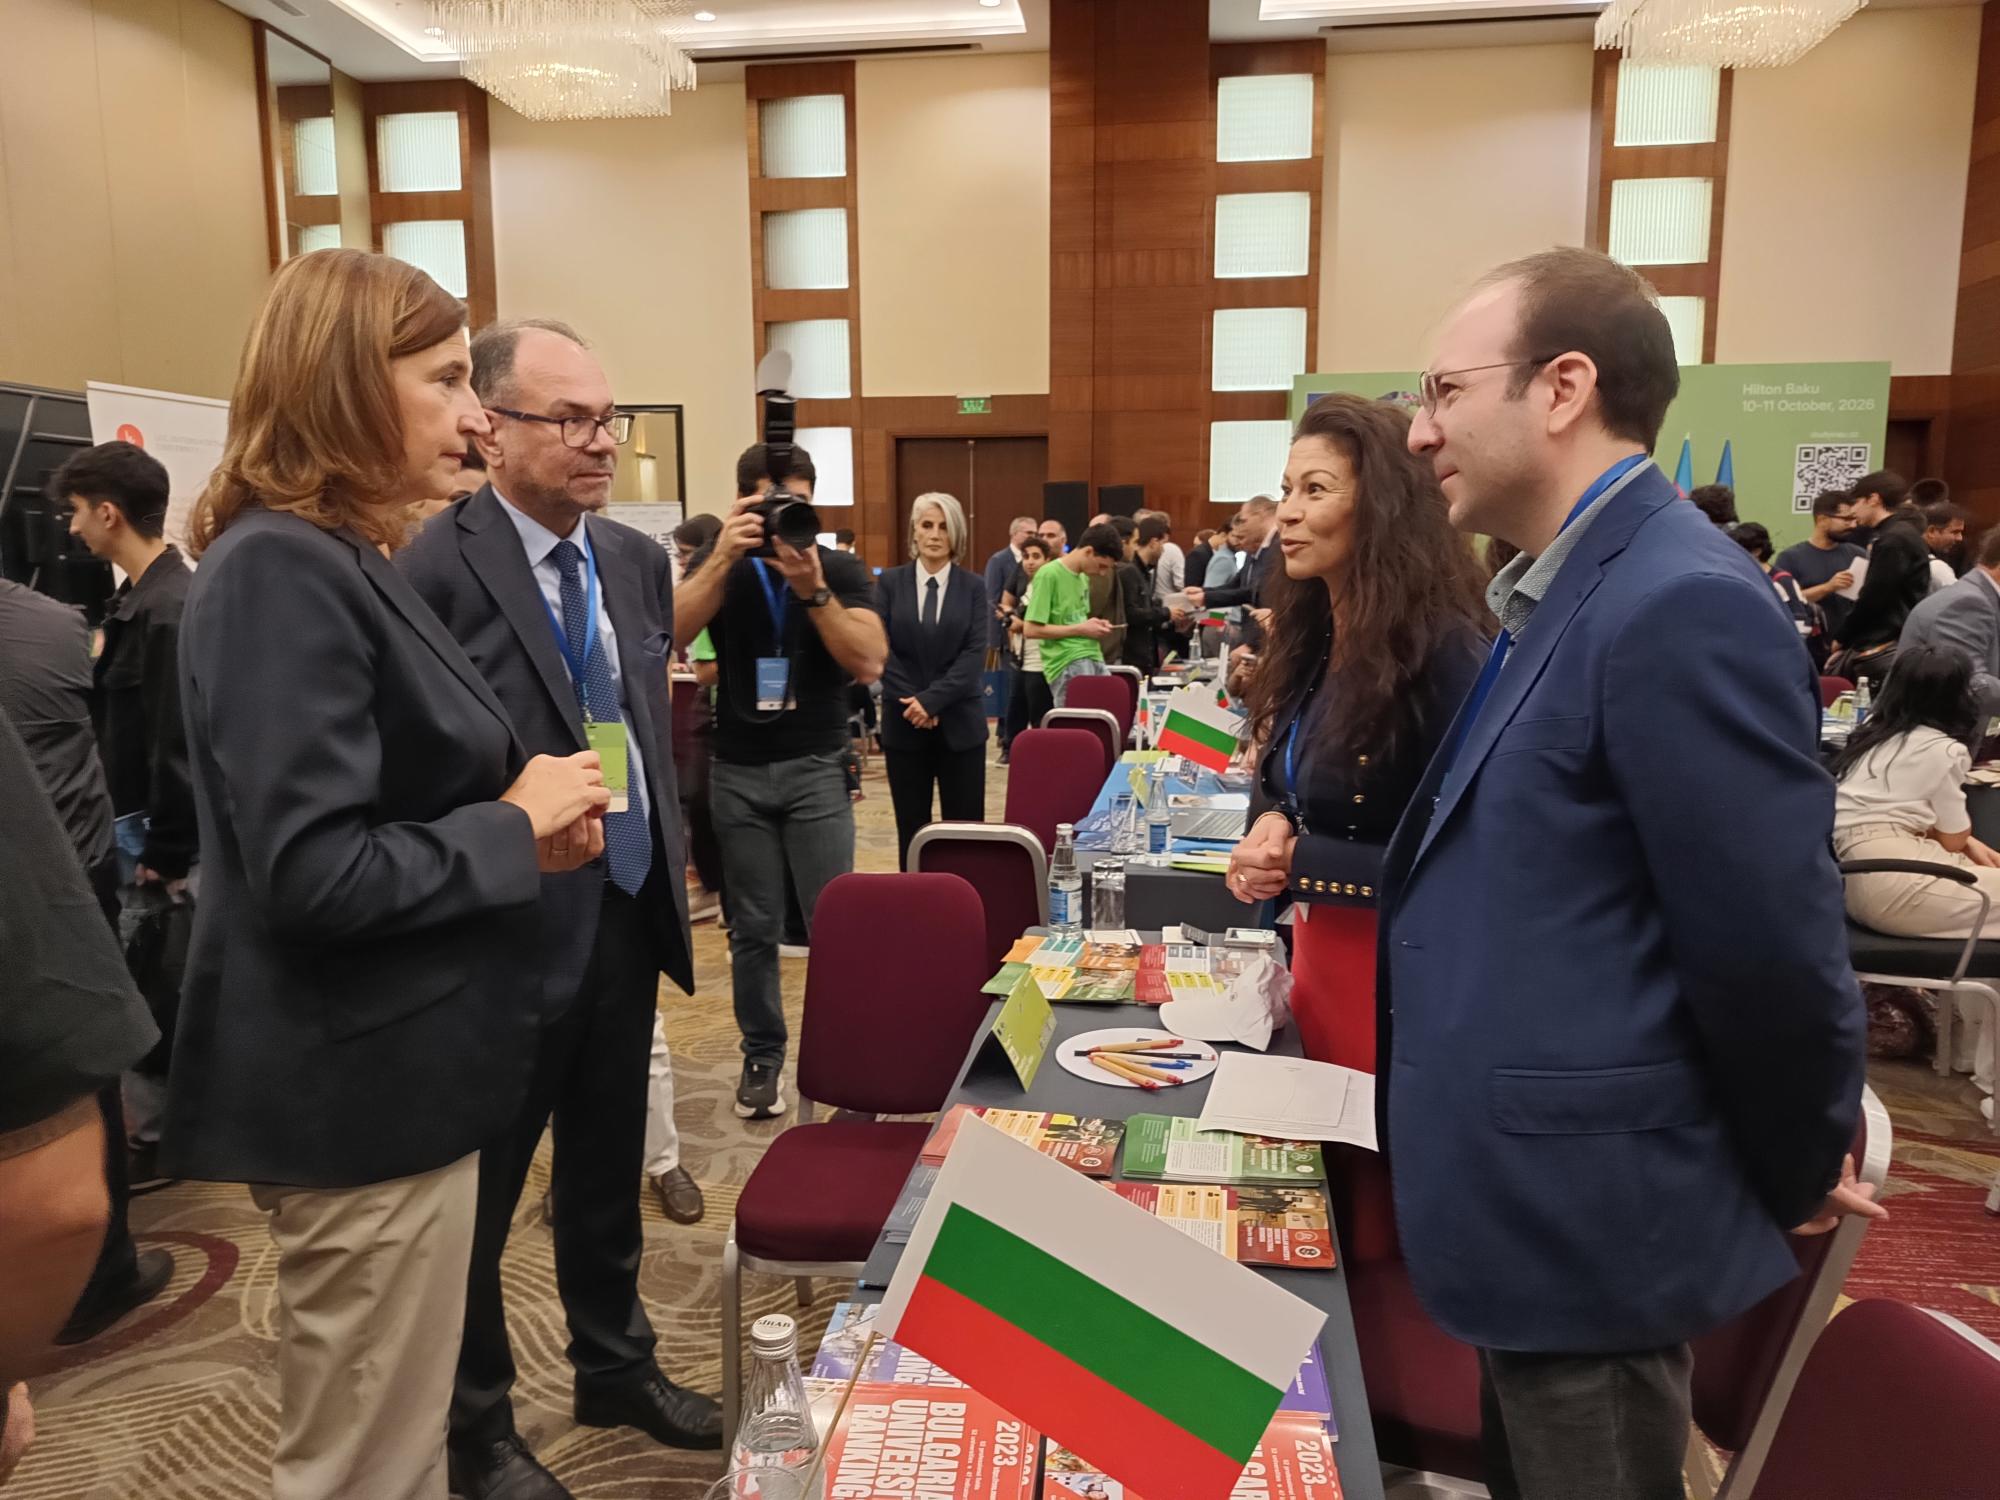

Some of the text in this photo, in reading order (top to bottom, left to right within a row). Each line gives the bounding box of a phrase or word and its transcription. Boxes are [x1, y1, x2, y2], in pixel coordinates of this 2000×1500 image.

[1742, 383, 1820, 395] Hilton Baku
[1743, 400, 1775, 412] 10-11
[1777, 400, 1835, 413] October,
[831, 1404, 891, 1500] RANKING
[872, 1399, 929, 1500] UNIVERSI
[993, 1420, 1021, 1467] 2023
[1295, 1439, 1328, 1485] 2023
